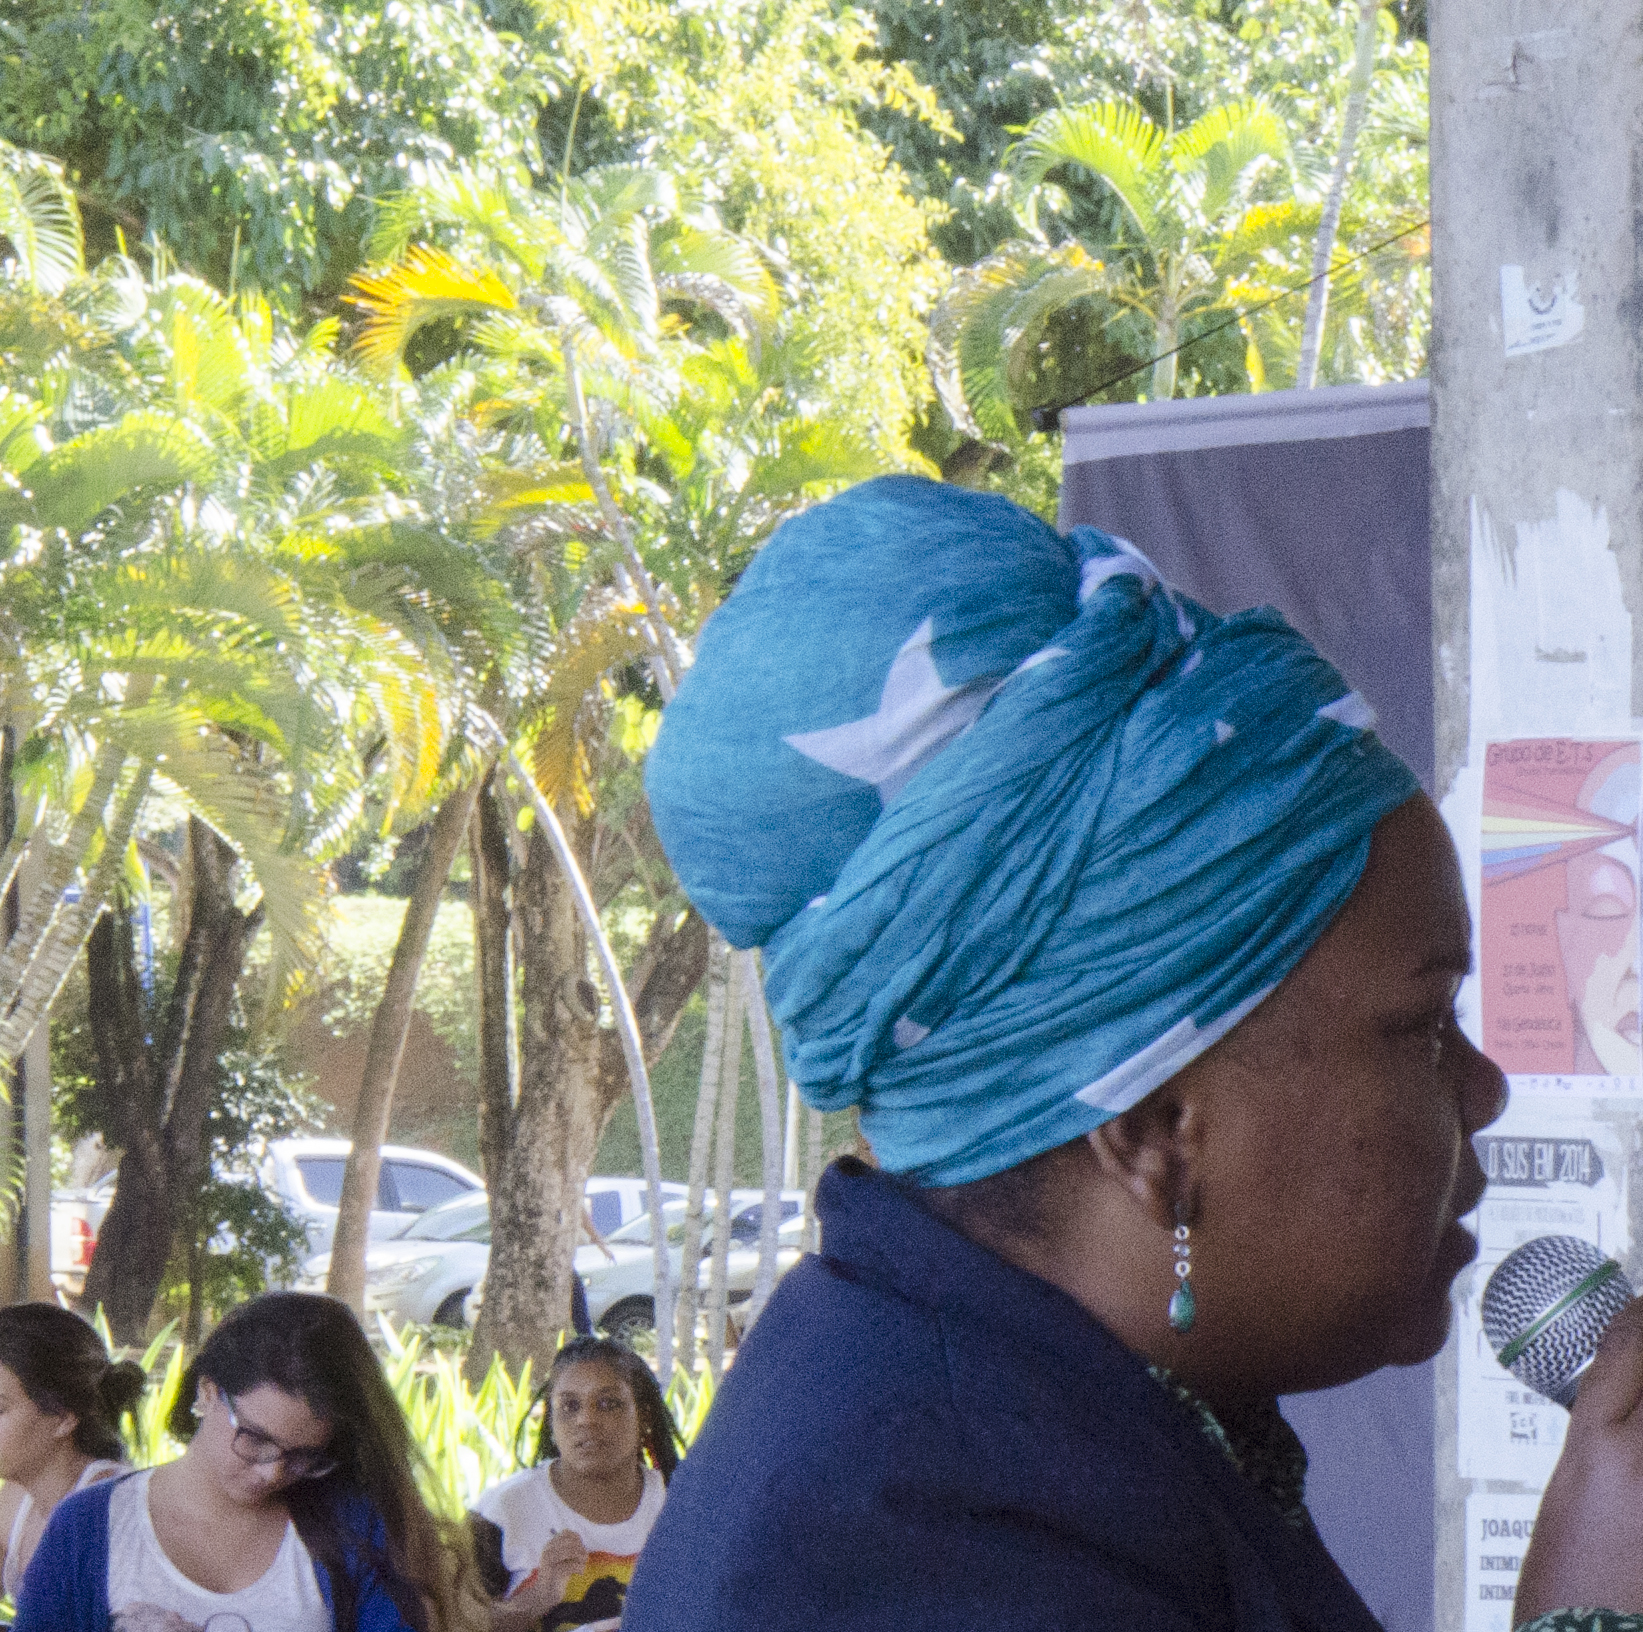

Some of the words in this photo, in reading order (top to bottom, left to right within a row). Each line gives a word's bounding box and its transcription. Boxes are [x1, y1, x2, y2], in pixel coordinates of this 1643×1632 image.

[1503, 1141, 1530, 1181] SUS
[1534, 1142, 1555, 1181] EM
[1559, 1143, 1592, 1183] 2014
